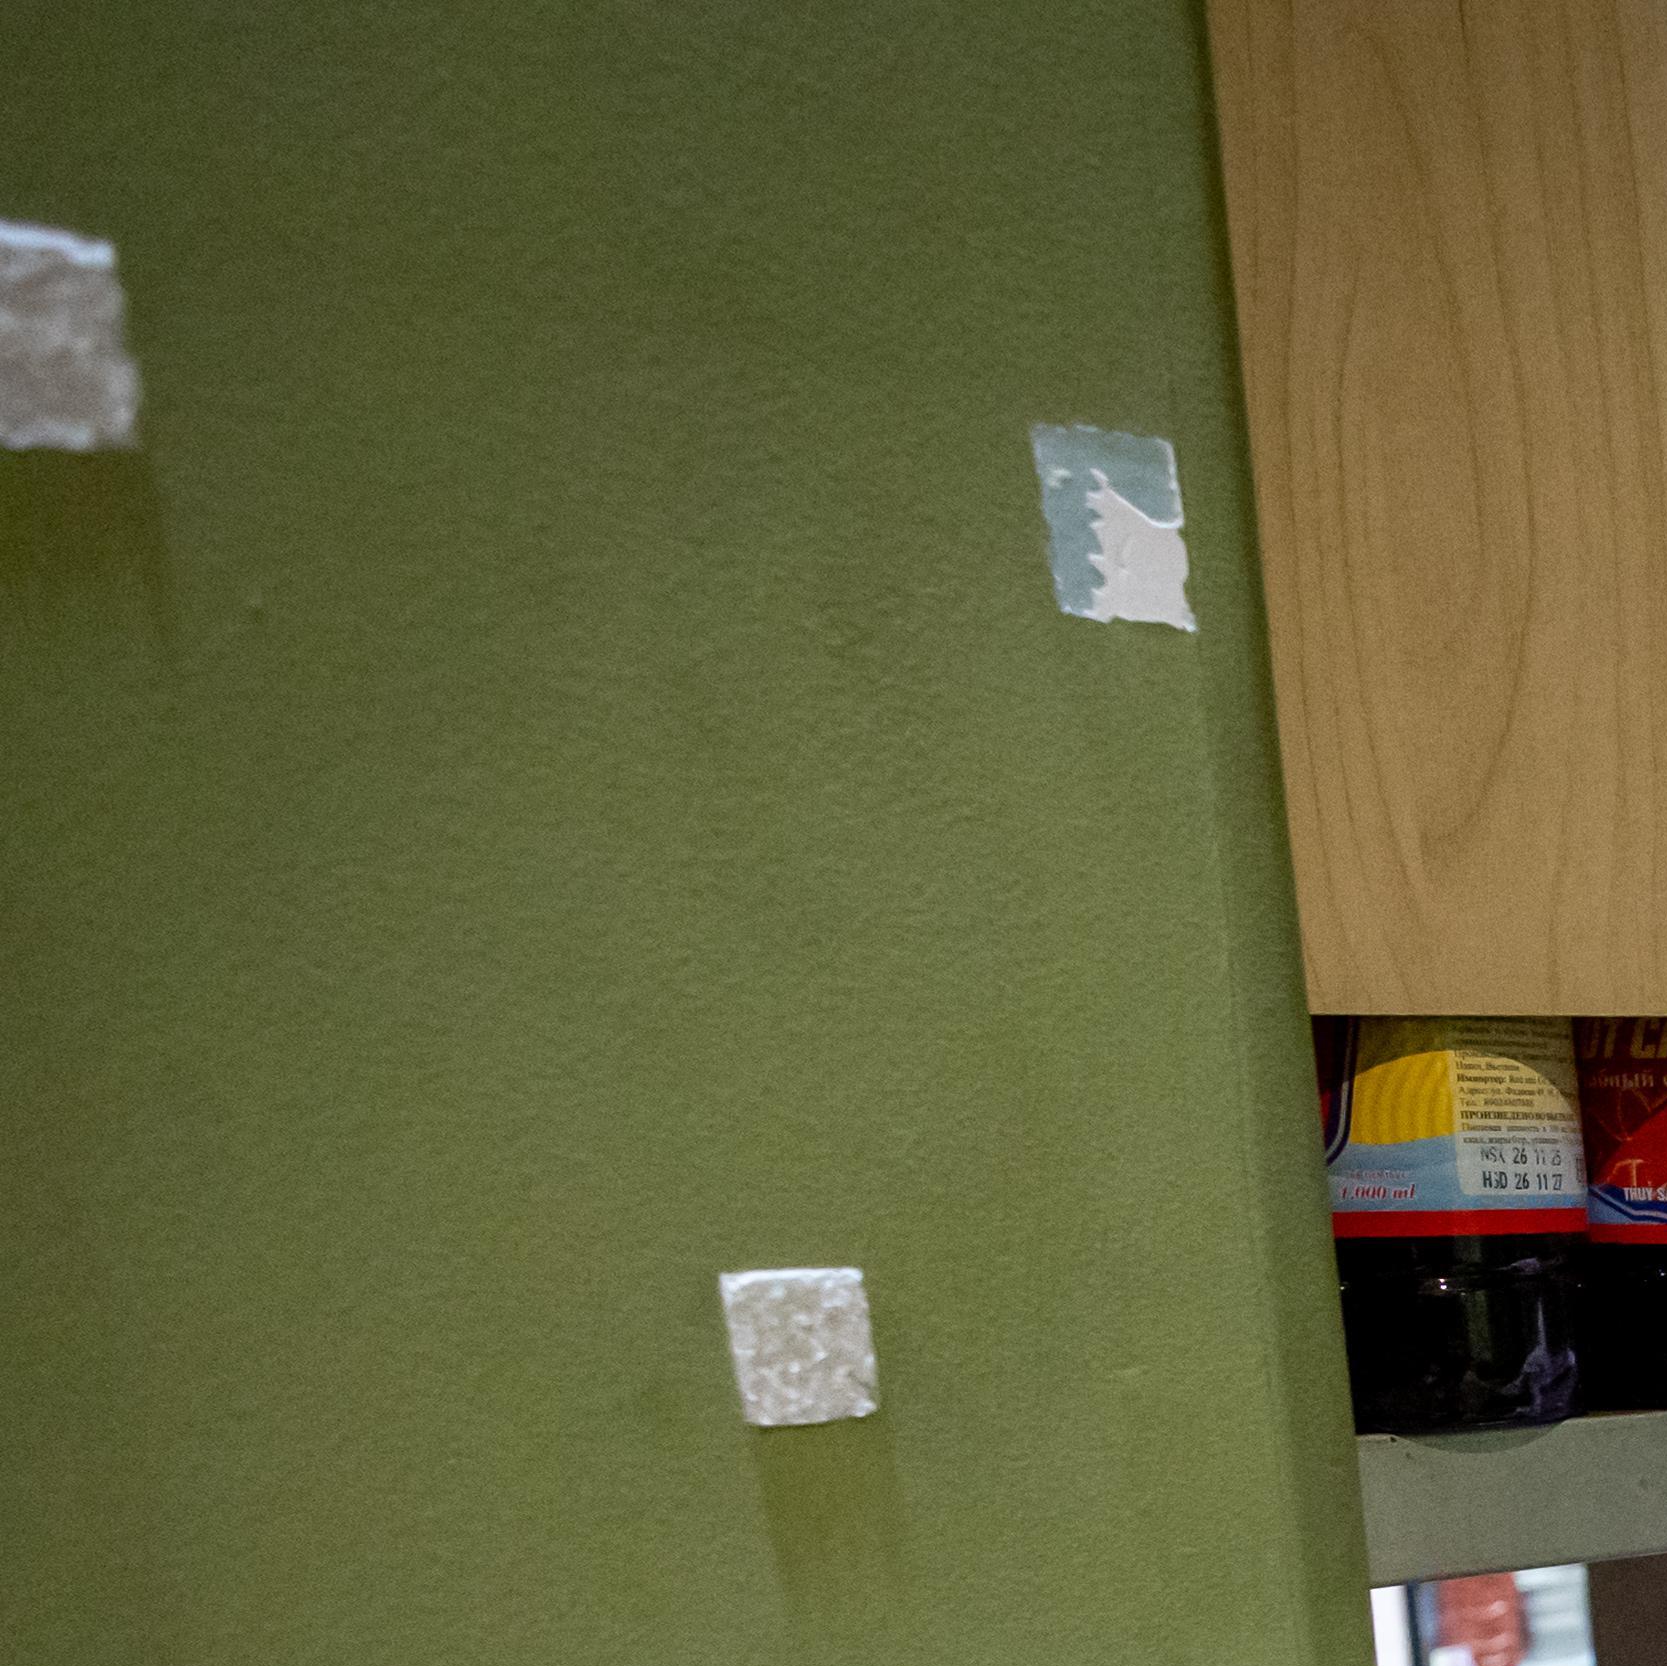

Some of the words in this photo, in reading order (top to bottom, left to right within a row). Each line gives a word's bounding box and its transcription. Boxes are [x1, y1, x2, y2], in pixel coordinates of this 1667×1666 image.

[1512, 1147, 1528, 1164] 26
[1514, 1172, 1530, 1190] 26
[1536, 1174, 1548, 1190] 11
[1392, 1184, 1415, 1199] ml
